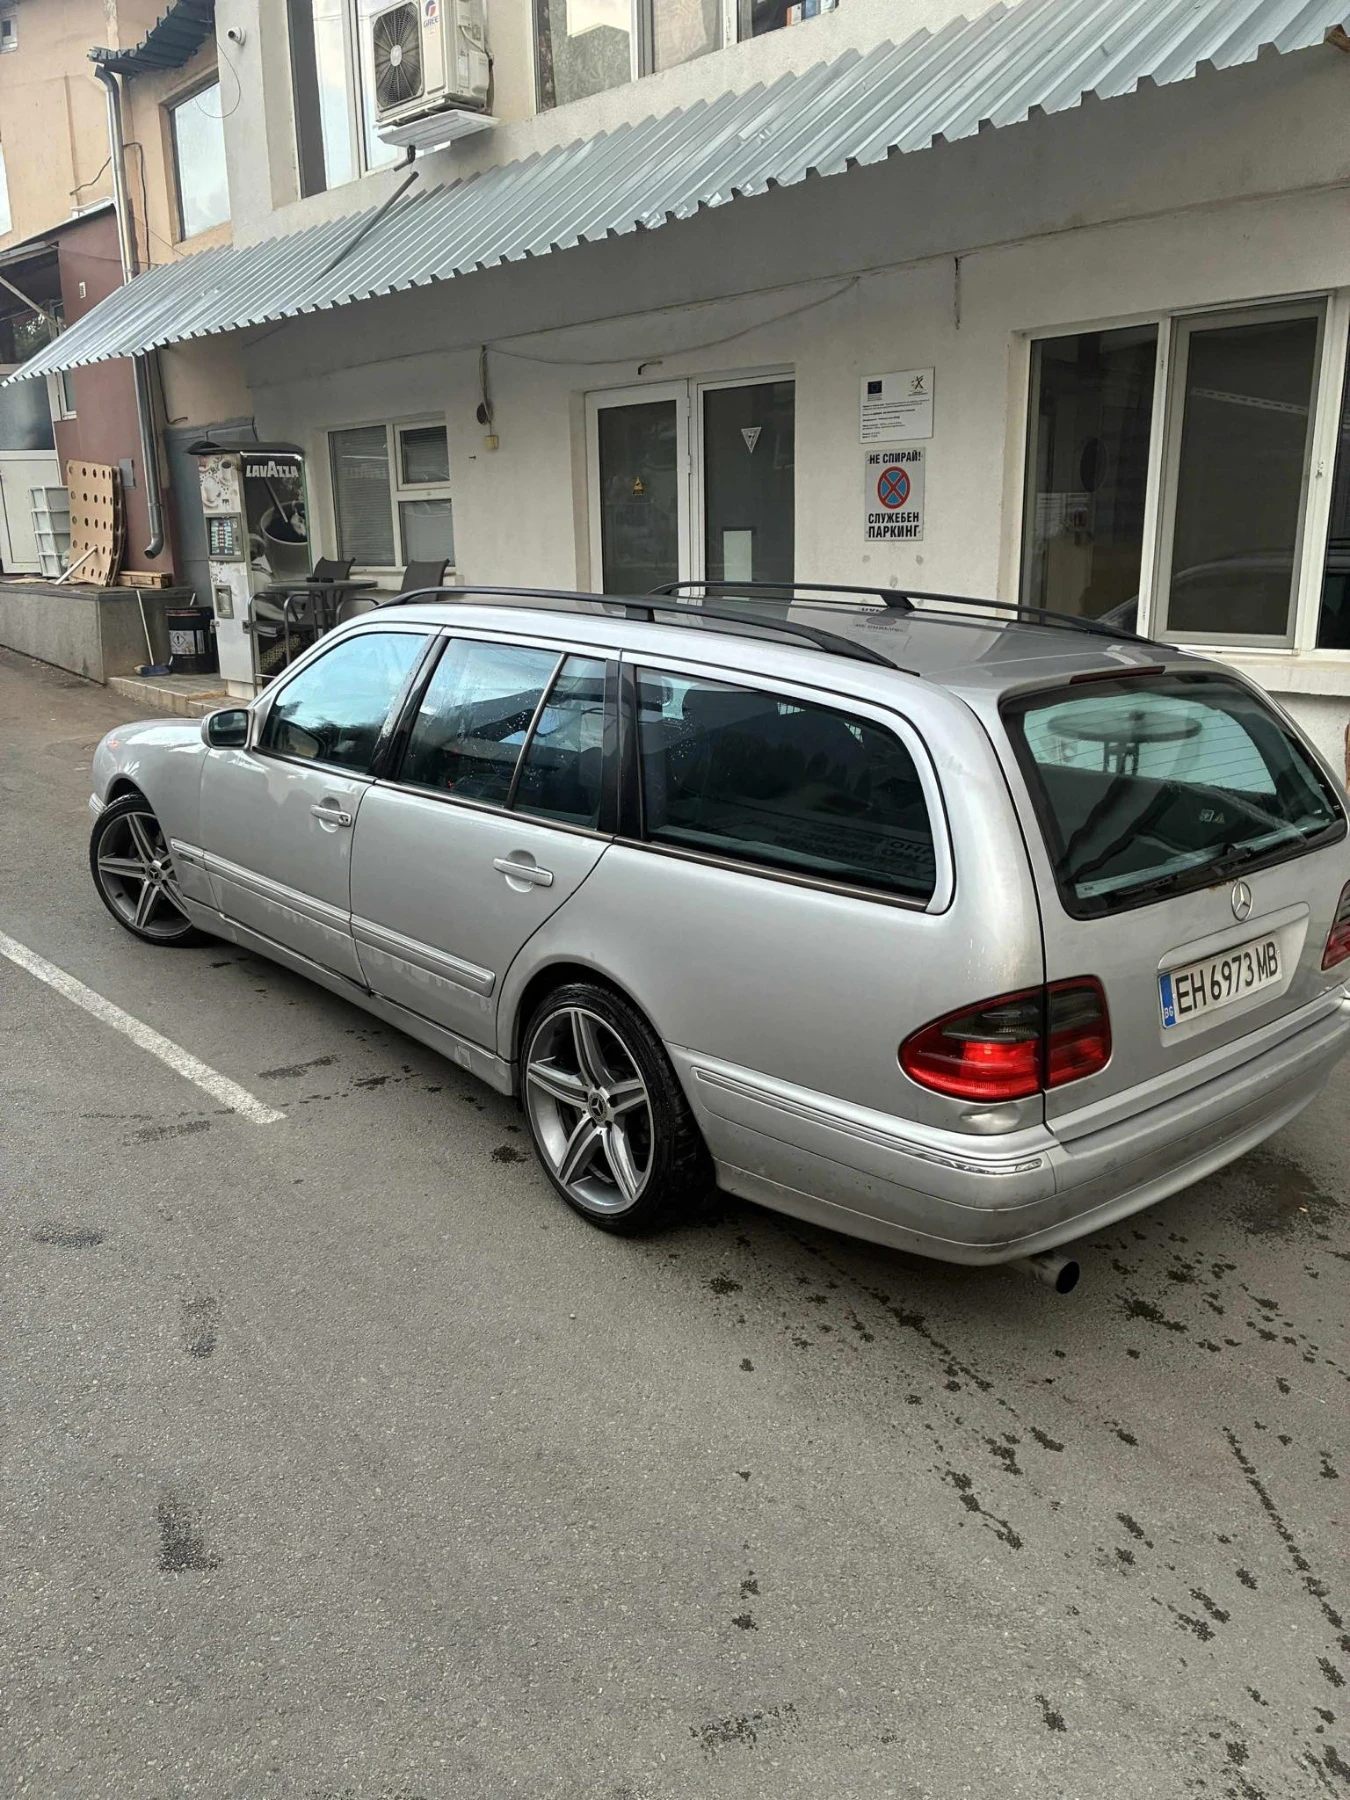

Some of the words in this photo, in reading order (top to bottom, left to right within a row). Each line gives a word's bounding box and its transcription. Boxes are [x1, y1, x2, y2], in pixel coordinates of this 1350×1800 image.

[869, 454, 881, 464] НЕ
[882, 450, 921, 463] СПИРАЙ!
[246, 461, 299, 478] LAVAZZA
[868, 512, 919, 524] СЛУЖЕБЕН
[868, 525, 919, 538] ПАРКИНГ
[1211, 952, 1254, 1001] 6973
[1164, 1006, 1174, 1019] BG
